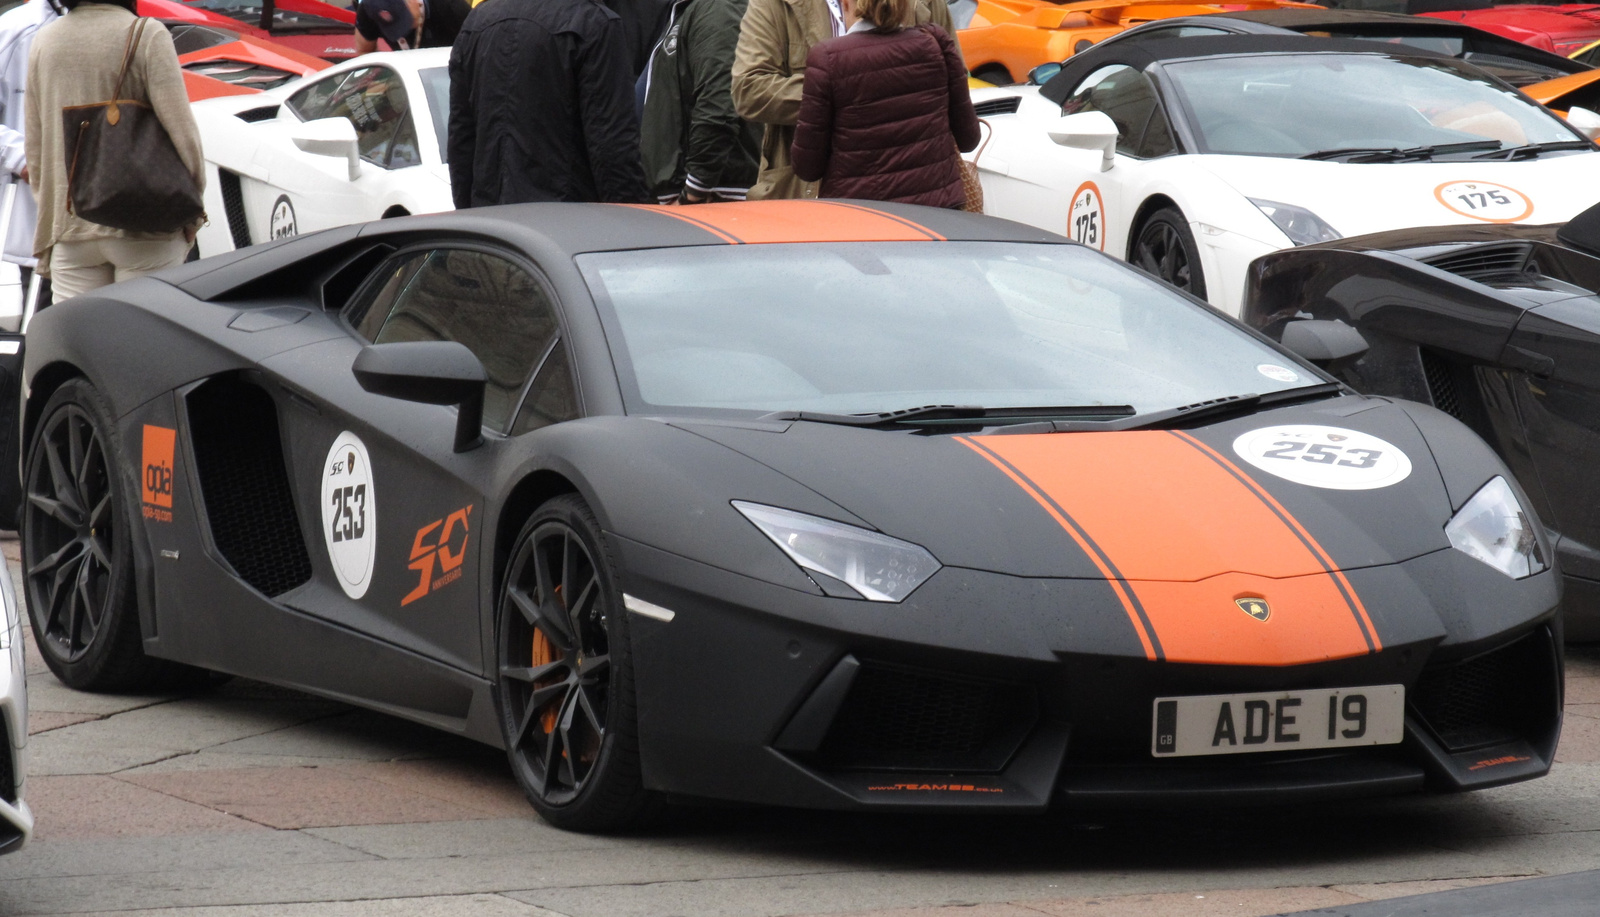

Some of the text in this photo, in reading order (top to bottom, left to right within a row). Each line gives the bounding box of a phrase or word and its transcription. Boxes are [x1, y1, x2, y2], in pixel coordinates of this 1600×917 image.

[1457, 189, 1512, 209] 175
[1076, 210, 1098, 244] 175
[1262, 440, 1383, 469] 253
[146, 460, 172, 502] opia
[331, 483, 366, 543] 253
[1211, 694, 1368, 747] ADE 19
[1160, 734, 1173, 746] GB
